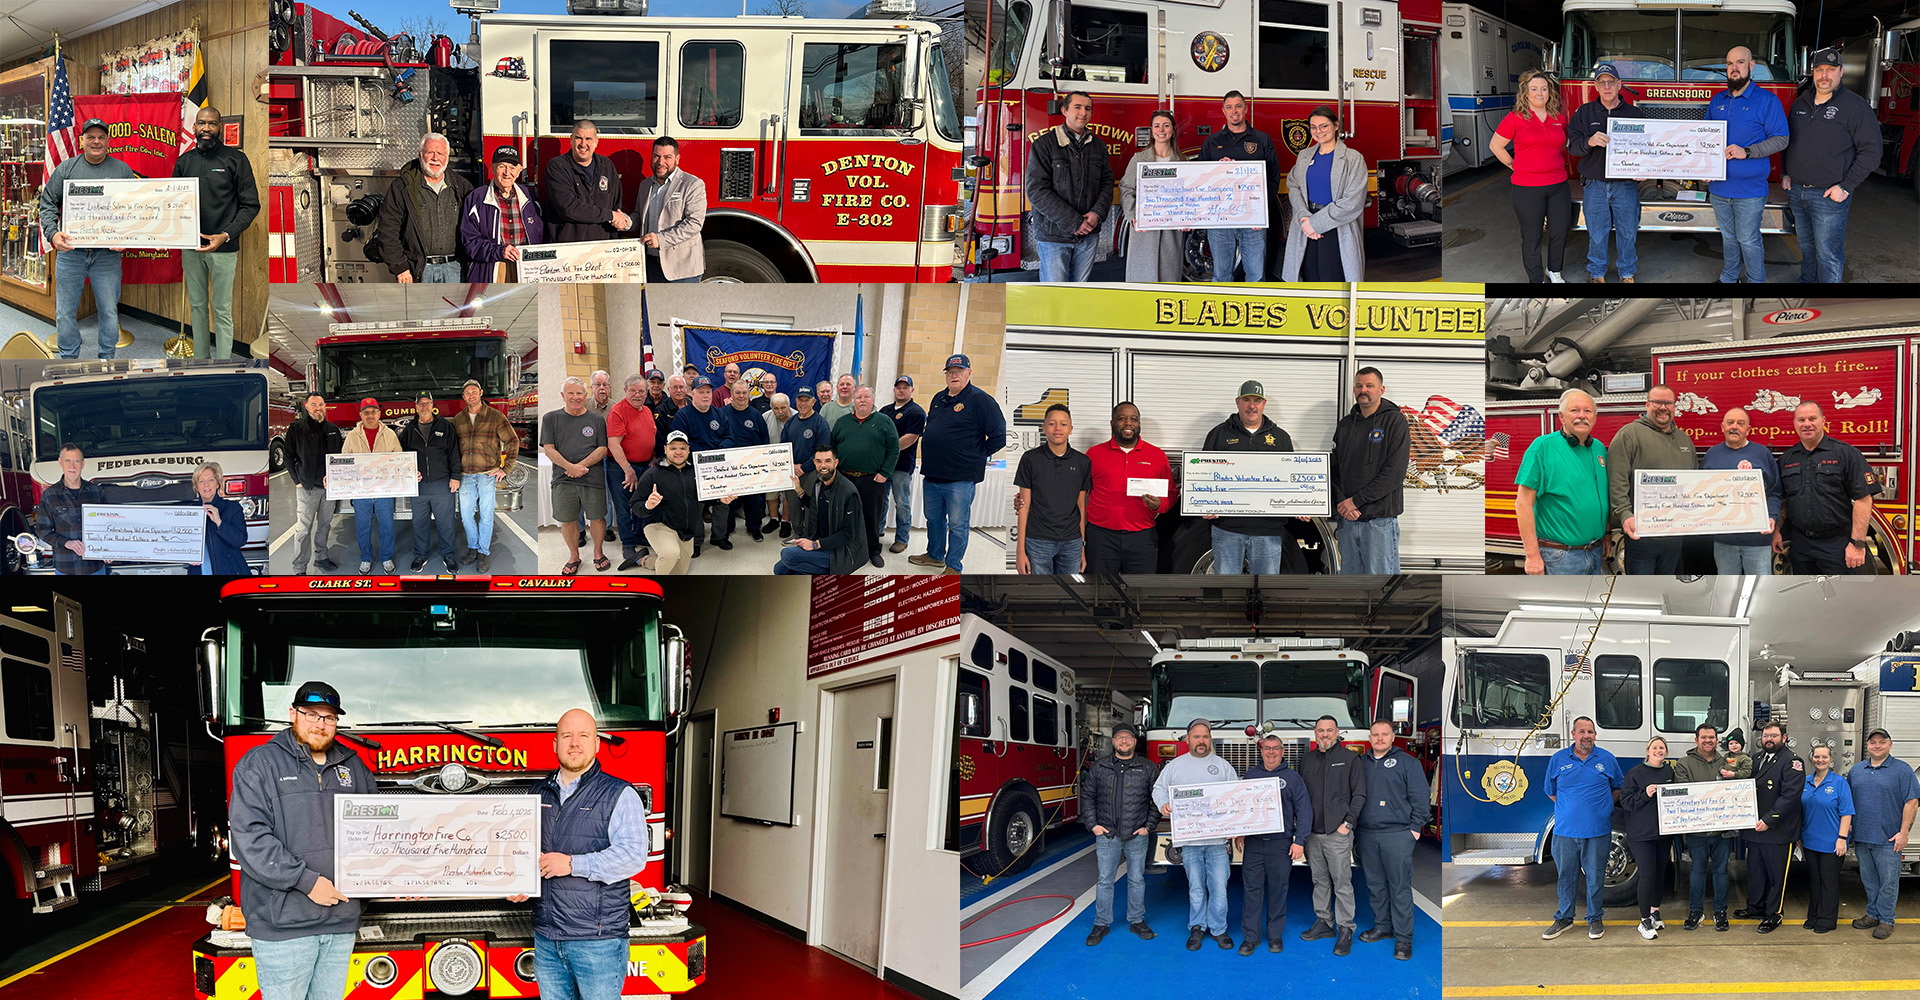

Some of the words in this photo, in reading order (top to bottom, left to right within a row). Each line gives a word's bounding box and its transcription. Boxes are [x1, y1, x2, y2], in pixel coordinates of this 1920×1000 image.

[1352, 68, 1387, 80] RESCUE
[1486, 70, 1494, 78] 16
[1365, 81, 1376, 91] 77
[1646, 88, 1712, 99] GREENSBORO
[1612, 120, 1645, 133] PRESTON
[820, 154, 994, 177] DENTON
[1142, 166, 1177, 178] PRESTON
[845, 175, 889, 189] VOL.
[821, 194, 872, 208] FIRE
[880, 194, 910, 208] CO.
[836, 213, 893, 227] E-302
[1662, 212, 1690, 220] Pierce
[139, 251, 170, 260] Maryland
[522, 248, 557, 261] PRESTON
[1155, 298, 1288, 329] BLADES
[1775, 312, 1808, 322] Pierce
[716, 355, 739, 364] SEAFORD
[1676, 370, 1688, 382] If
[1694, 372, 1724, 384] your
[1731, 367, 1780, 380] clothes
[1787, 362, 1827, 375] catch
[1834, 360, 1879, 373] fire...
[1254, 385, 1263, 394] 71
[385, 407, 439, 416] GUMBO
[1676, 426, 1718, 440] top...
[1751, 425, 1796, 440] rop...
[1840, 420, 1889, 434] Roll!
[97, 456, 205, 472] FEDERALSBURG
[1214, 471, 1233, 481] Blades
[1640, 472, 1677, 485] PRESTON
[1191, 483, 1212, 492] Twenty
[1190, 496, 1219, 505] Community
[308, 579, 352, 588] CLARK
[354, 579, 373, 588] ST.
[518, 578, 574, 588] CAVALRY
[898, 586, 909, 594] FIELD
[912, 578, 928, 588] WOODS
[898, 594, 922, 607] ELECTRICAL
[923, 587, 942, 597] HAZARD
[898, 610, 914, 620] MEDICAL
[918, 599, 944, 612] MANPOWER
[840, 649, 851, 657] CARD
[868, 637, 888, 649] CHANGED
[895, 630, 916, 640] ANYTIME
[925, 616, 960, 631] DISCRETION
[843, 655, 860, 664] SERVICE
[377, 744, 528, 770] HARRINGTON
[1661, 787, 1688, 797] PRESTON
[1677, 799, 1700, 807] Secretary
[343, 800, 399, 820] PRESTON
[373, 824, 433, 845] Harrington
[435, 826, 454, 841] Fire
[368, 843, 388, 855] Two
[392, 841, 429, 855] Thousand
[433, 843, 450, 855] Five
[450, 843, 488, 855] Hundred
[443, 866, 463, 876] Preston
[494, 866, 515, 877] Group
